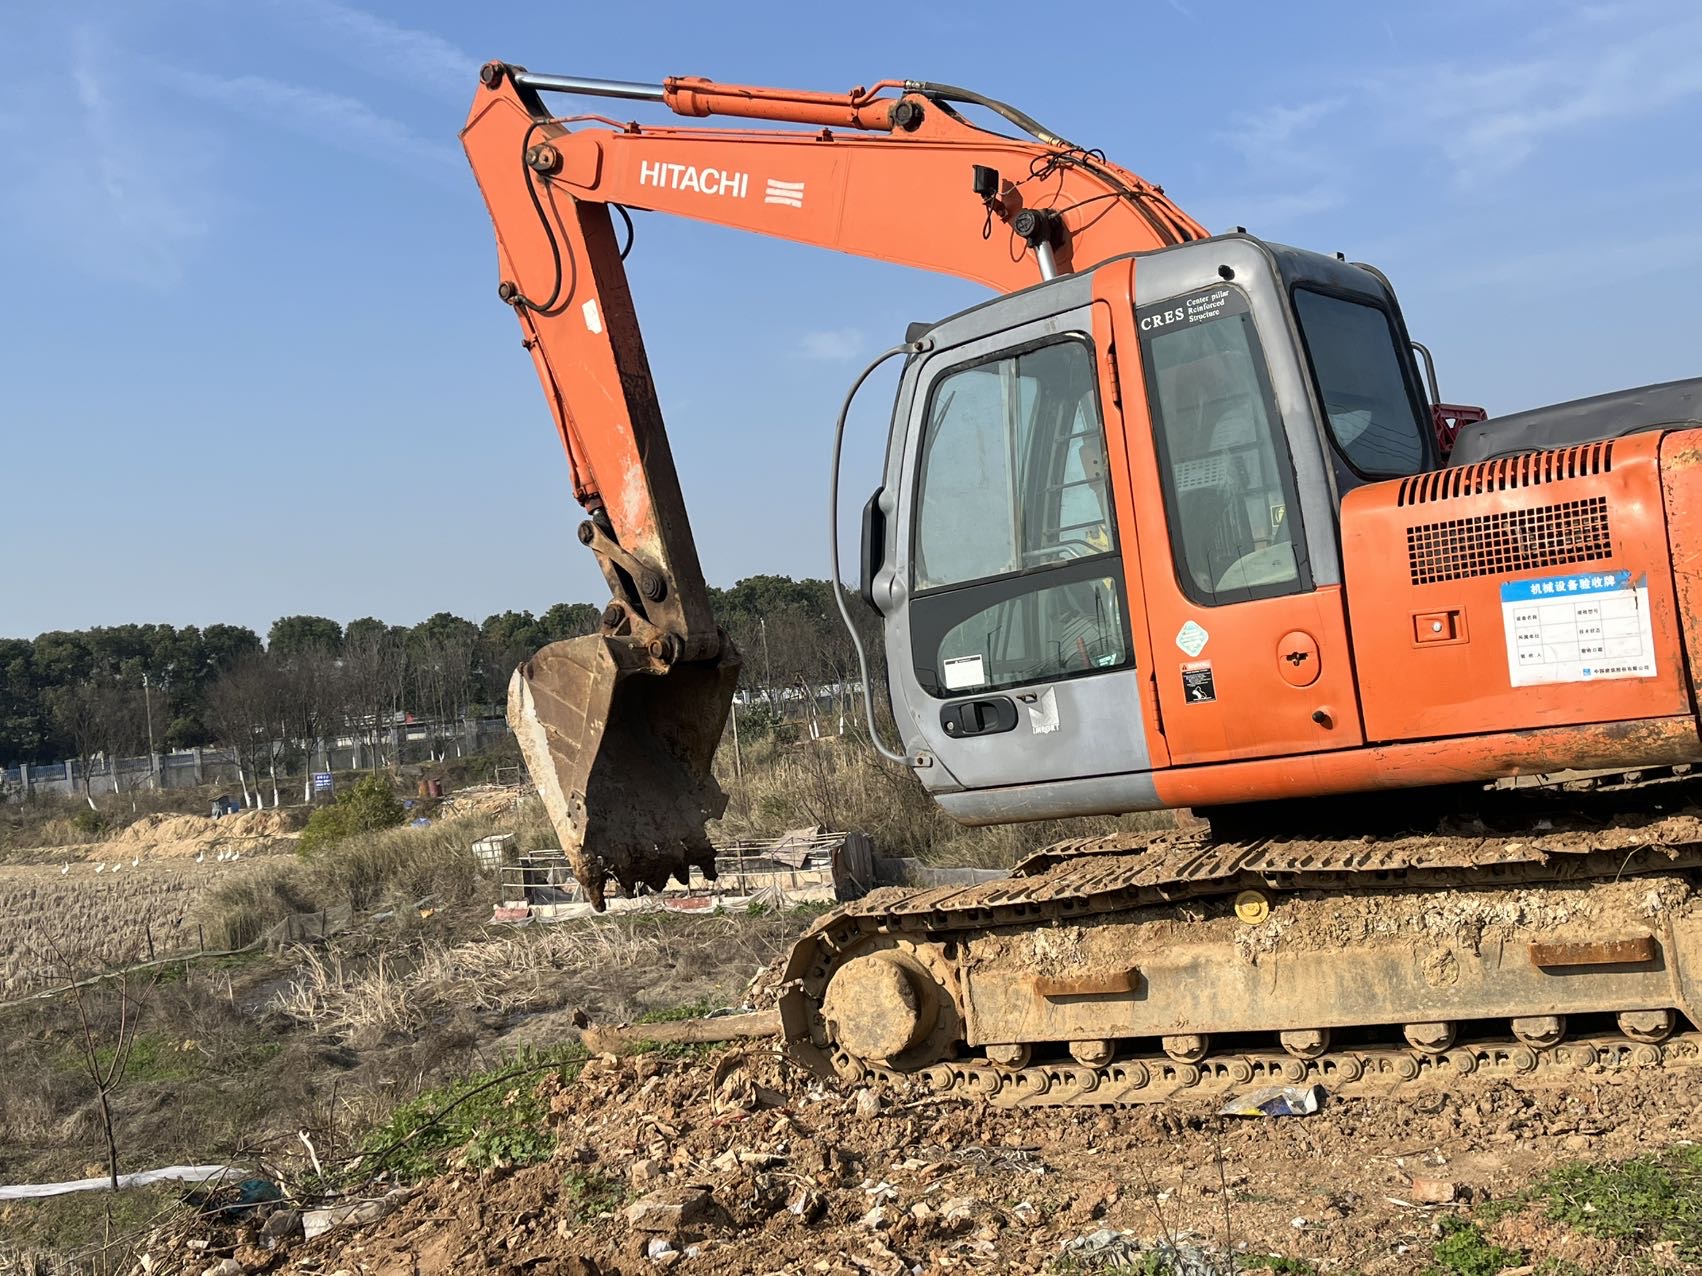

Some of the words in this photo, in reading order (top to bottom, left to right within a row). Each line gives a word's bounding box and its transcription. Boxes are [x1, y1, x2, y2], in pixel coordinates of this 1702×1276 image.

[640, 160, 748, 198] HITACHI
[1186, 296, 1209, 307] Center
[1211, 290, 1230, 302] pillar
[1187, 299, 1225, 315] Reinforced
[1140, 307, 1185, 331] CRES
[1188, 309, 1220, 323] Structure
[1530, 575, 1616, 595] 机械设备验收牌
